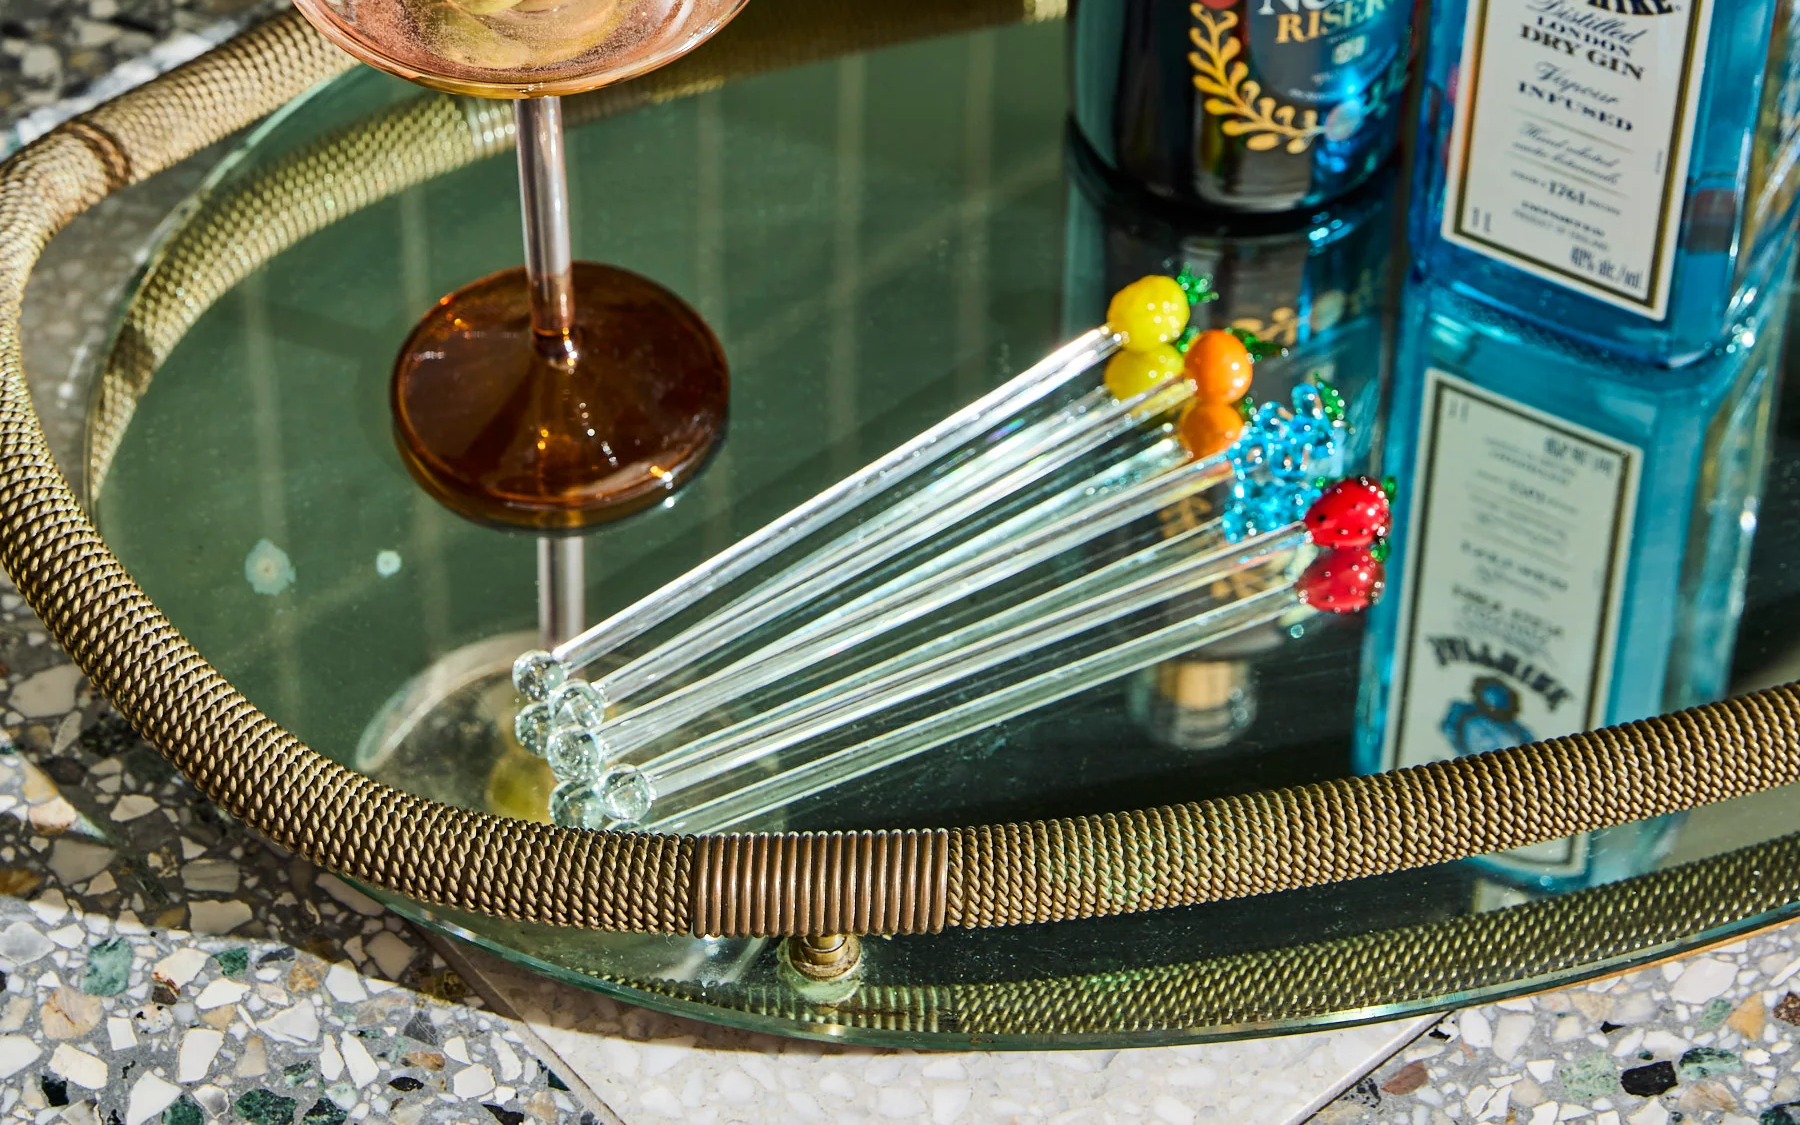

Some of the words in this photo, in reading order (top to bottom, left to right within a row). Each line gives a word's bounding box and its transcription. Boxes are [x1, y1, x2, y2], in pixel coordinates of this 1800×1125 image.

[1520, 24, 1581, 56] DRY
[1587, 49, 1645, 81] GIN
[1536, 15, 1632, 58] LONDON
[1517, 80, 1633, 132] INFUSED
[1549, 179, 1586, 206] 1761
